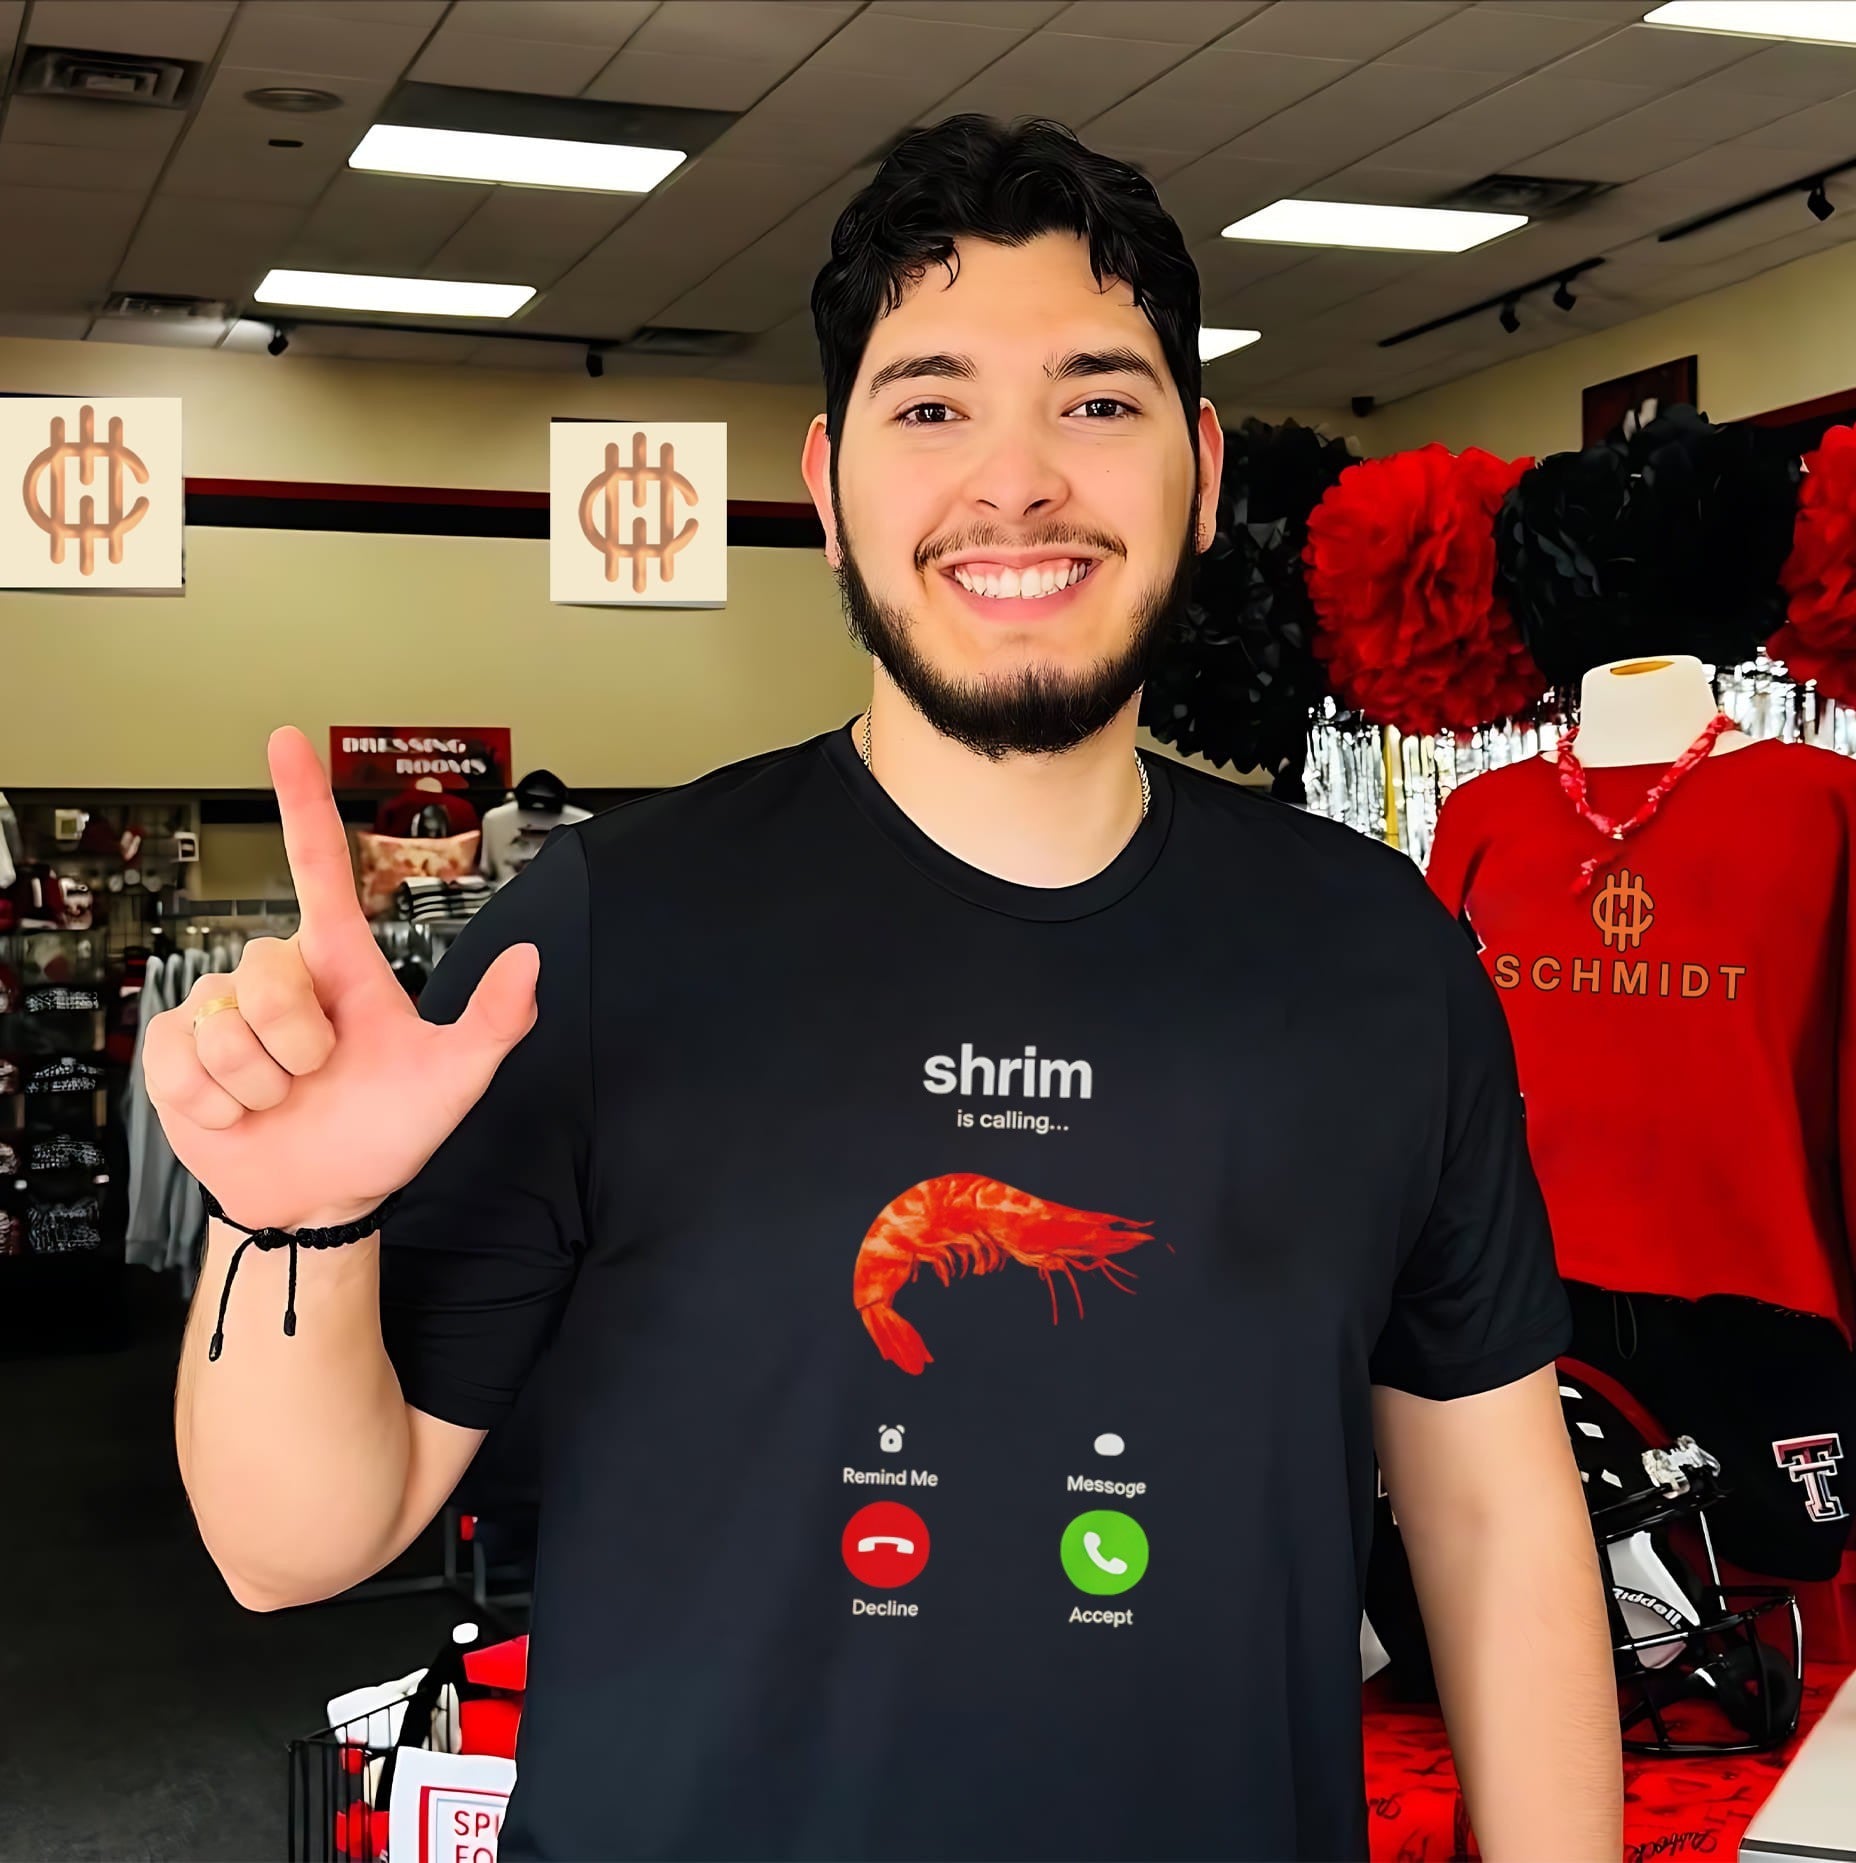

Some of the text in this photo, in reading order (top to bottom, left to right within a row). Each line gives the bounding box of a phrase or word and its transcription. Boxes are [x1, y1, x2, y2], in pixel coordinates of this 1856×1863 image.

[396, 758, 487, 775] ROOMS
[1493, 953, 1747, 1001] SCHMIDT
[923, 1043, 1093, 1099] shrim
[957, 1109, 1069, 1135] is calling...
[843, 1467, 939, 1488] Remind Me
[852, 1599, 919, 1617] Decline
[1069, 1607, 1133, 1628] Accept
